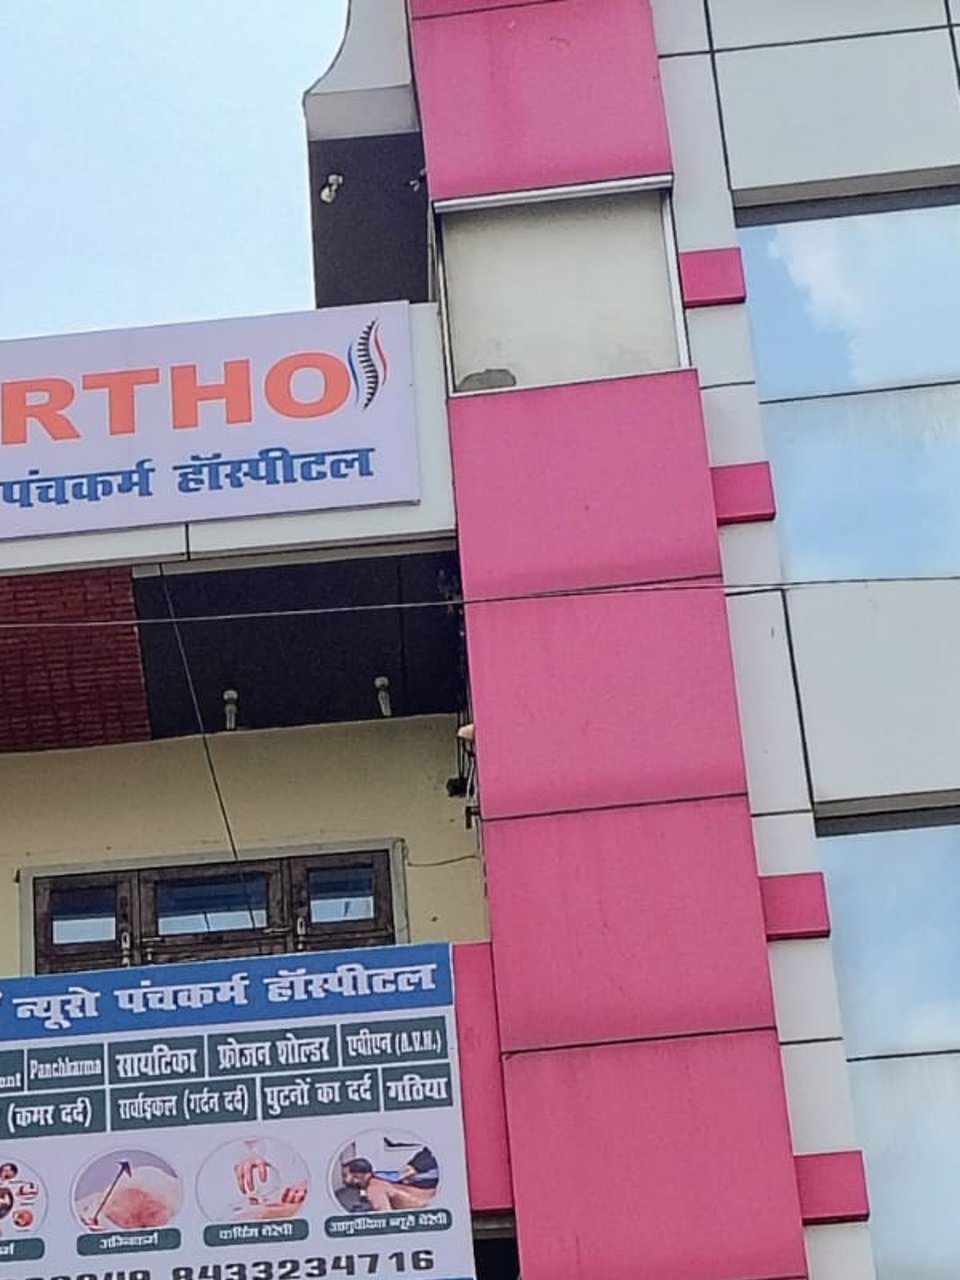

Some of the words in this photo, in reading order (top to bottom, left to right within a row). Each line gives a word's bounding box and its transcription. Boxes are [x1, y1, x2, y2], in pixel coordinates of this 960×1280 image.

[172, 446, 377, 493] हॉस्पीटल
[13, 986, 100, 1029] न्यूरो
[114, 973, 250, 1014] पंचकर्म
[263, 961, 438, 1000] हॉस्पीटल
[217, 1037, 272, 1070] फ्रोजन
[276, 1032, 330, 1064] शोल्डर
[346, 1028, 393, 1057] एवीएन
[29, 1057, 102, 1080] Panchkarma
[115, 1044, 197, 1078] सायटिका
[315, 1082, 341, 1103] का
[345, 1073, 372, 1101] दर्द
[386, 1073, 449, 1102] गठिया
[7, 1103, 54, 1133] (कमर
